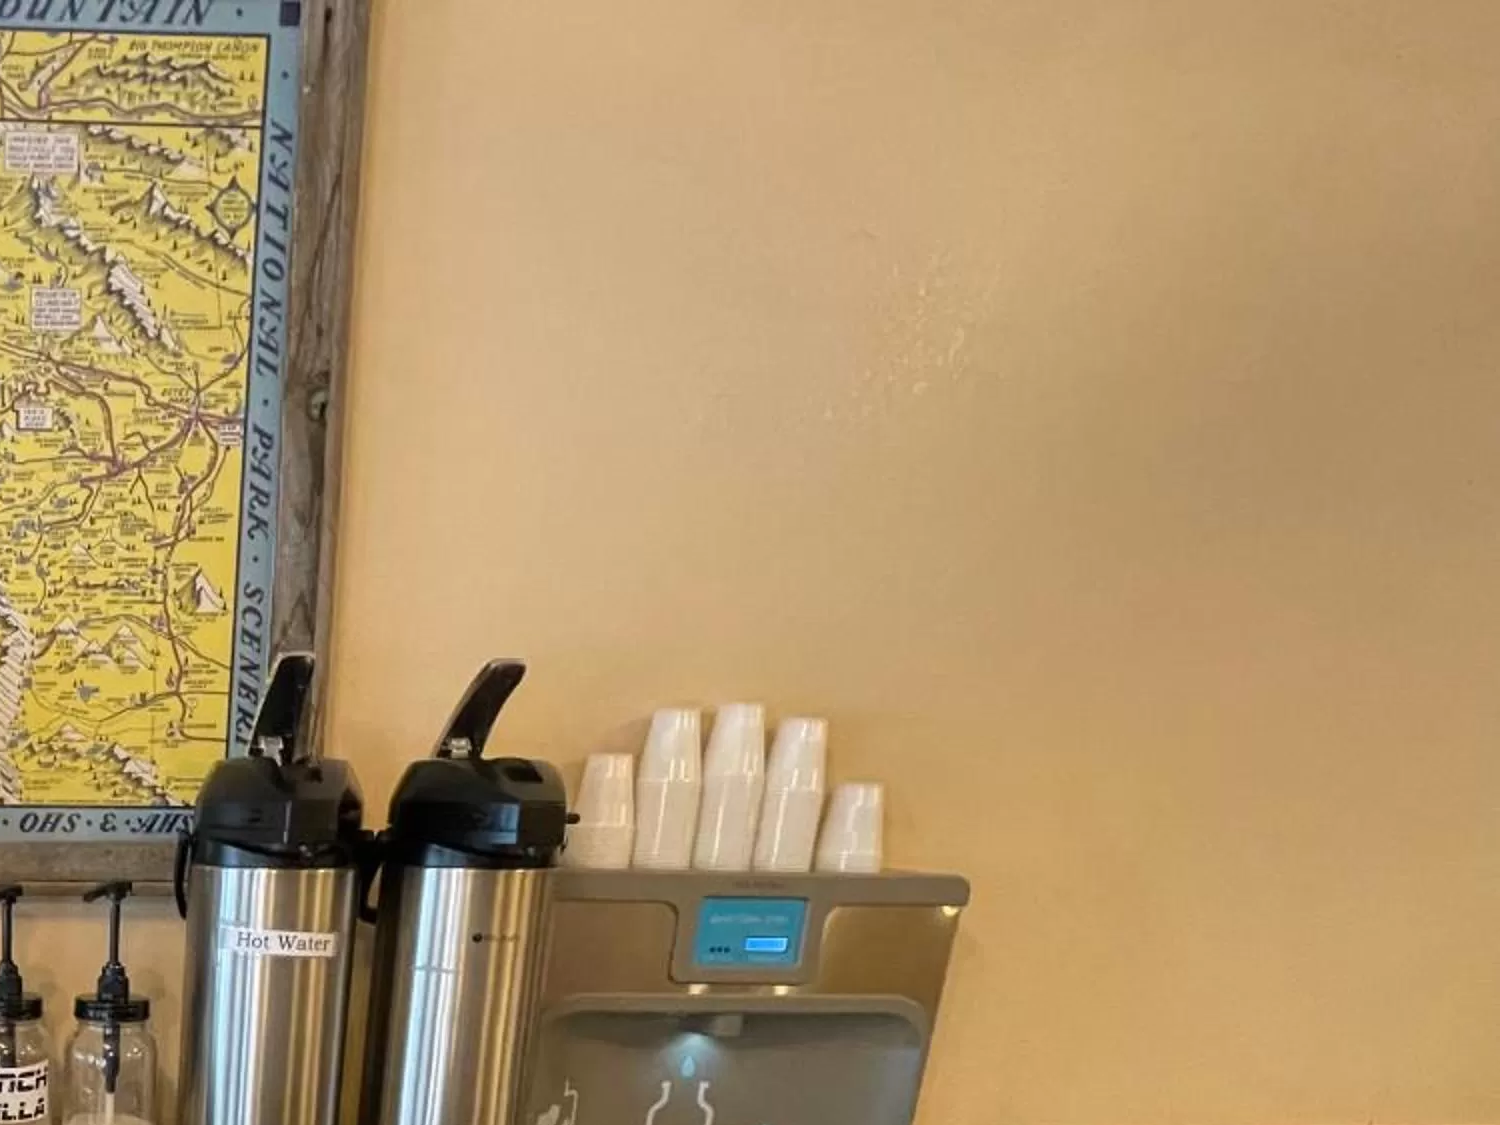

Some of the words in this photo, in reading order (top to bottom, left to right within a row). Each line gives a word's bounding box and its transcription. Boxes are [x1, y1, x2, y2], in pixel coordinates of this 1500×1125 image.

[255, 119, 294, 377] NATIONAL
[247, 422, 275, 540] PARK
[18, 812, 82, 833] OHS
[236, 930, 269, 950] Hot
[278, 934, 332, 952] Water
